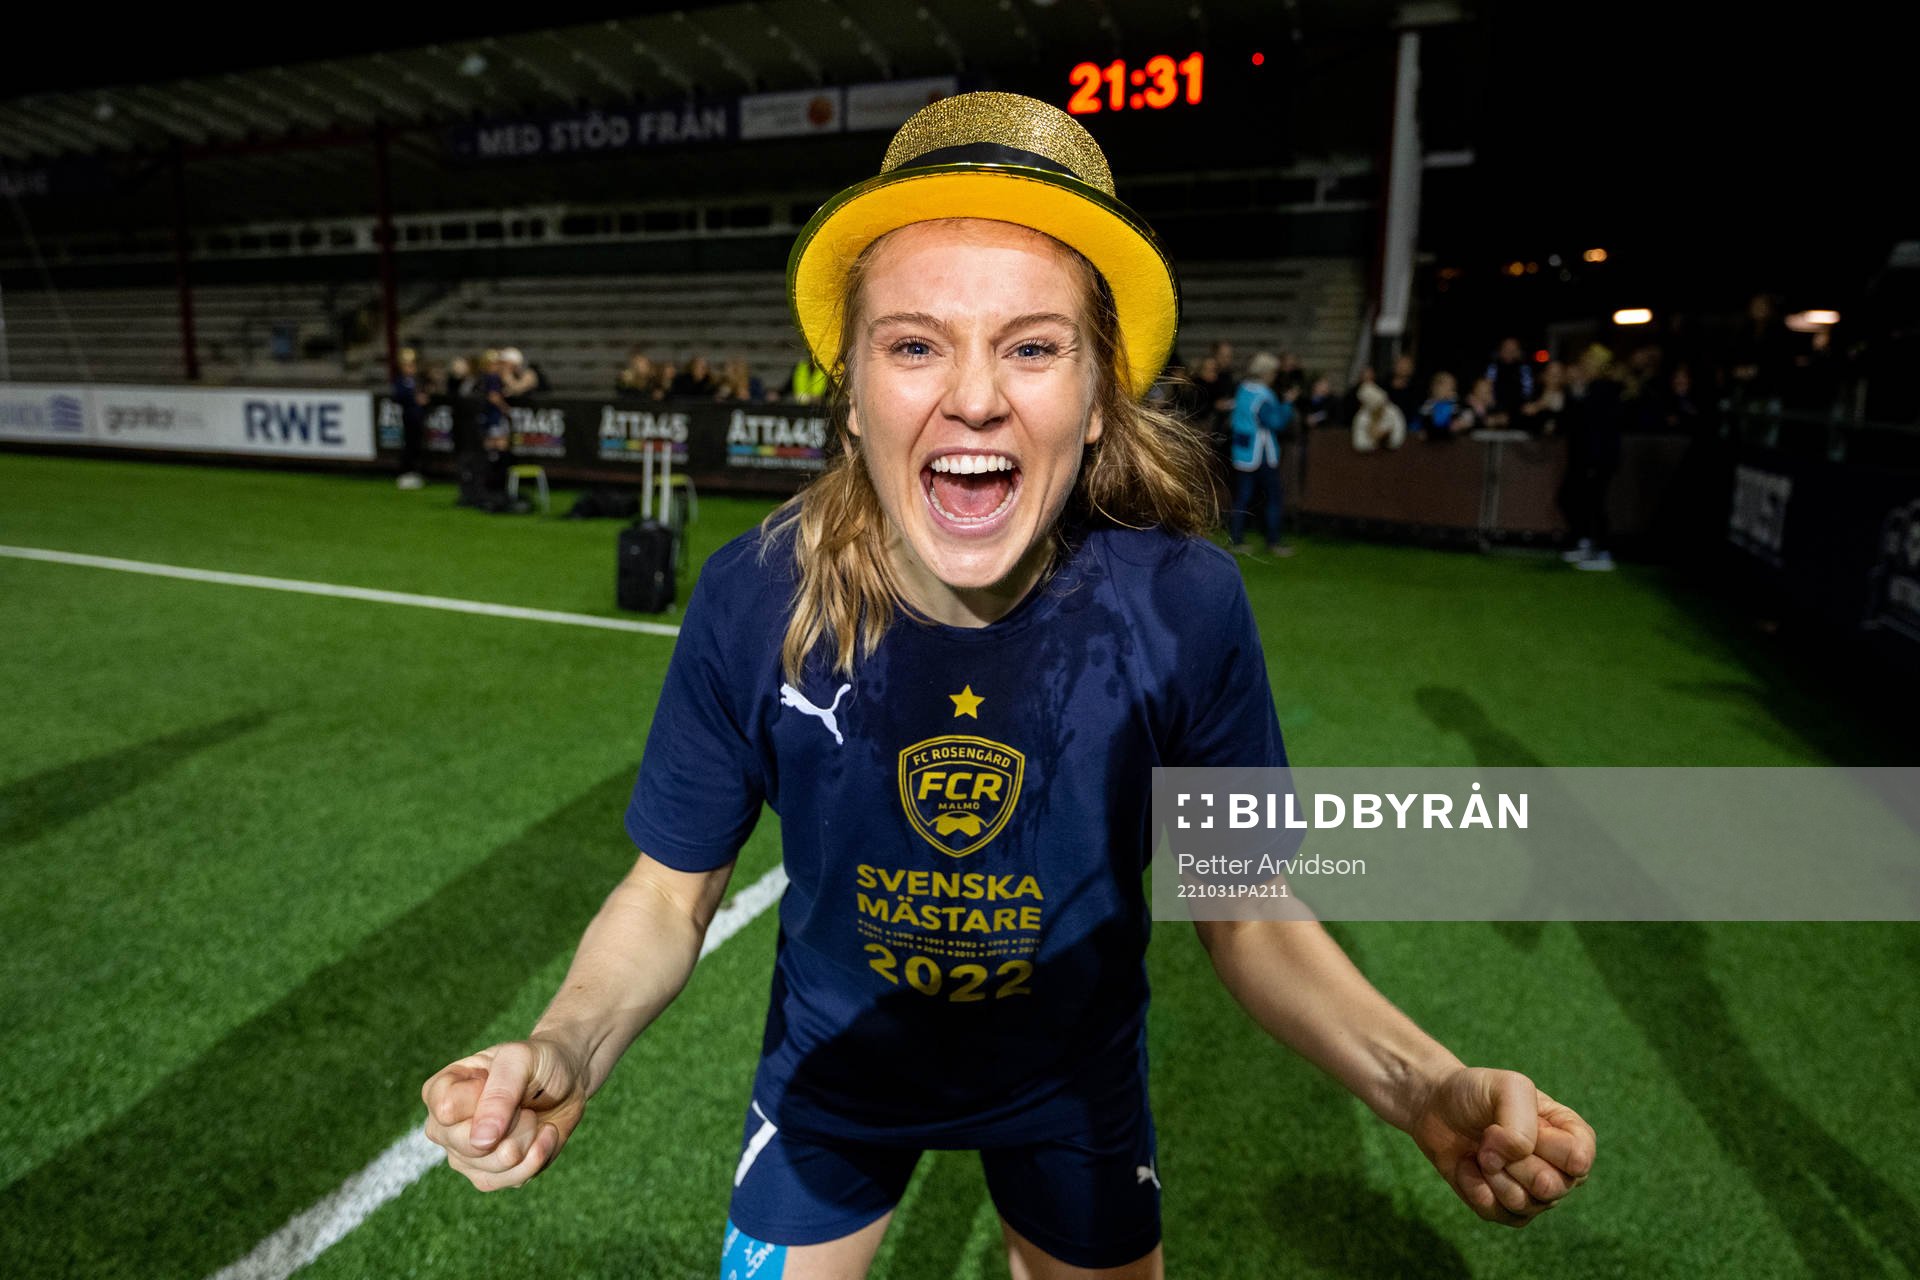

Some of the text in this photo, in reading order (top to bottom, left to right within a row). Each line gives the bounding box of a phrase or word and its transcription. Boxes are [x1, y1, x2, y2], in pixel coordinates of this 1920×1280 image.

[1067, 51, 1204, 115] 21:31
[478, 122, 542, 155] MED
[549, 110, 629, 151] STÖD
[638, 101, 727, 143] FRÅN
[244, 400, 345, 445] RWE
[599, 405, 689, 443] ÅTTA45
[727, 408, 827, 448] ÅTTA45
[913, 747, 1011, 769] FC ROSENGÅRD
[917, 771, 1003, 801] FCR
[938, 801, 980, 810] MALMÖ
[856, 864, 1044, 901] SVENSKA
[856, 892, 1042, 934] MÄSTARE
[863, 943, 1033, 1003] 2022
